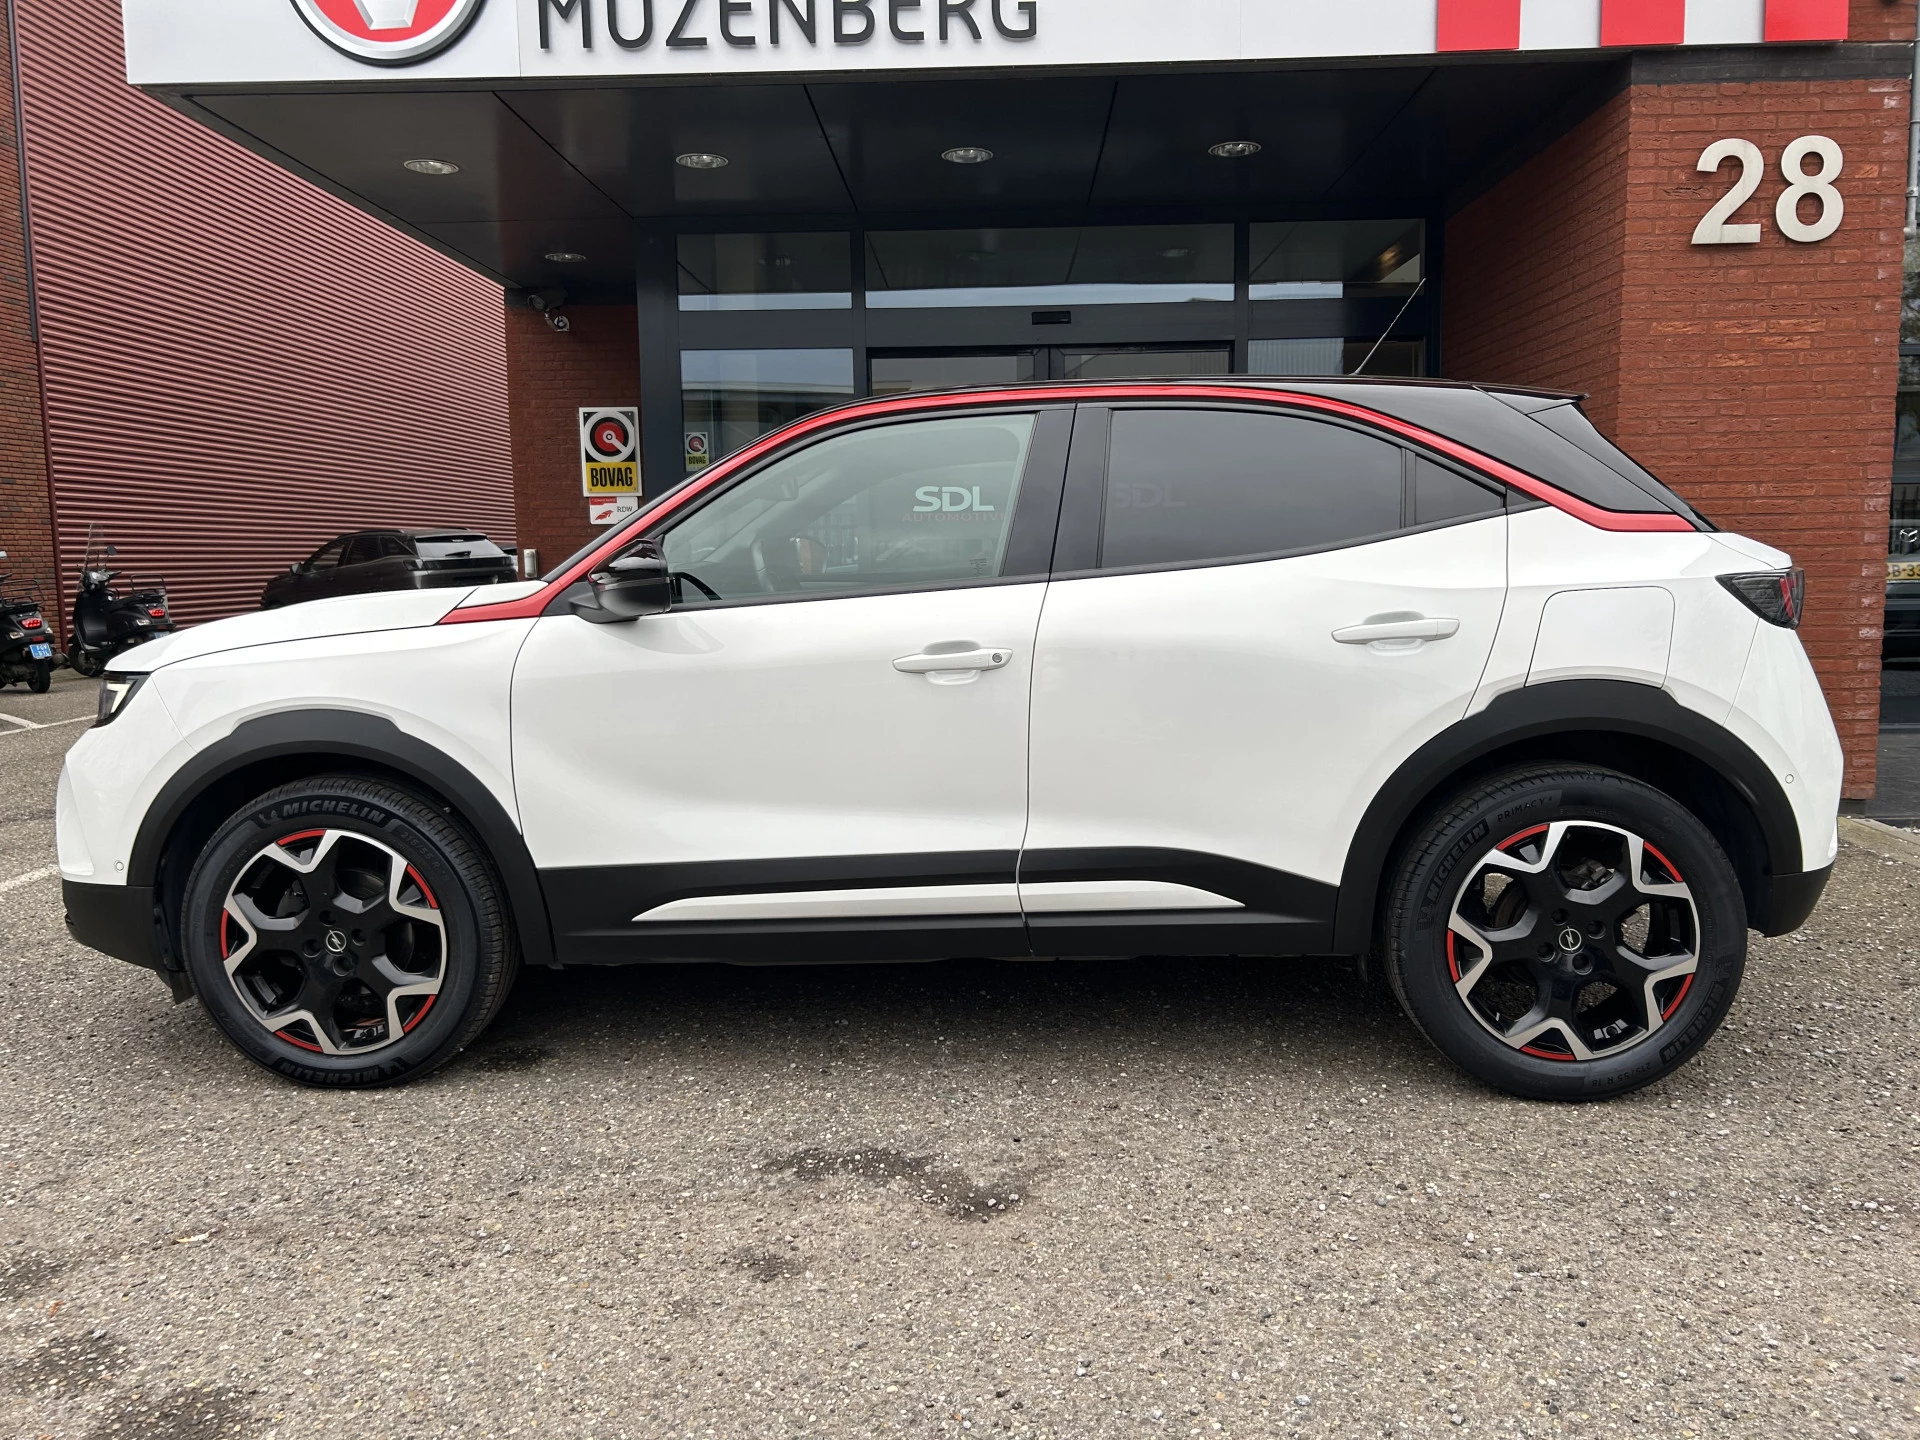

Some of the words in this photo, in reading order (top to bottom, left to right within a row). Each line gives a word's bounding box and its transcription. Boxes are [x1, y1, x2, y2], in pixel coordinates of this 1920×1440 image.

[1691, 135, 1844, 244] 28
[688, 455, 707, 465] BOVAG
[590, 466, 633, 488] BOVAG
[912, 485, 995, 512] SDL
[283, 800, 386, 823] MICHELIN
[1497, 798, 1545, 823] PRIMACY
[1427, 823, 1486, 902] MICHELIN
[1663, 983, 1724, 1063] MICHELIN
[280, 1062, 380, 1083] MICHELIN
